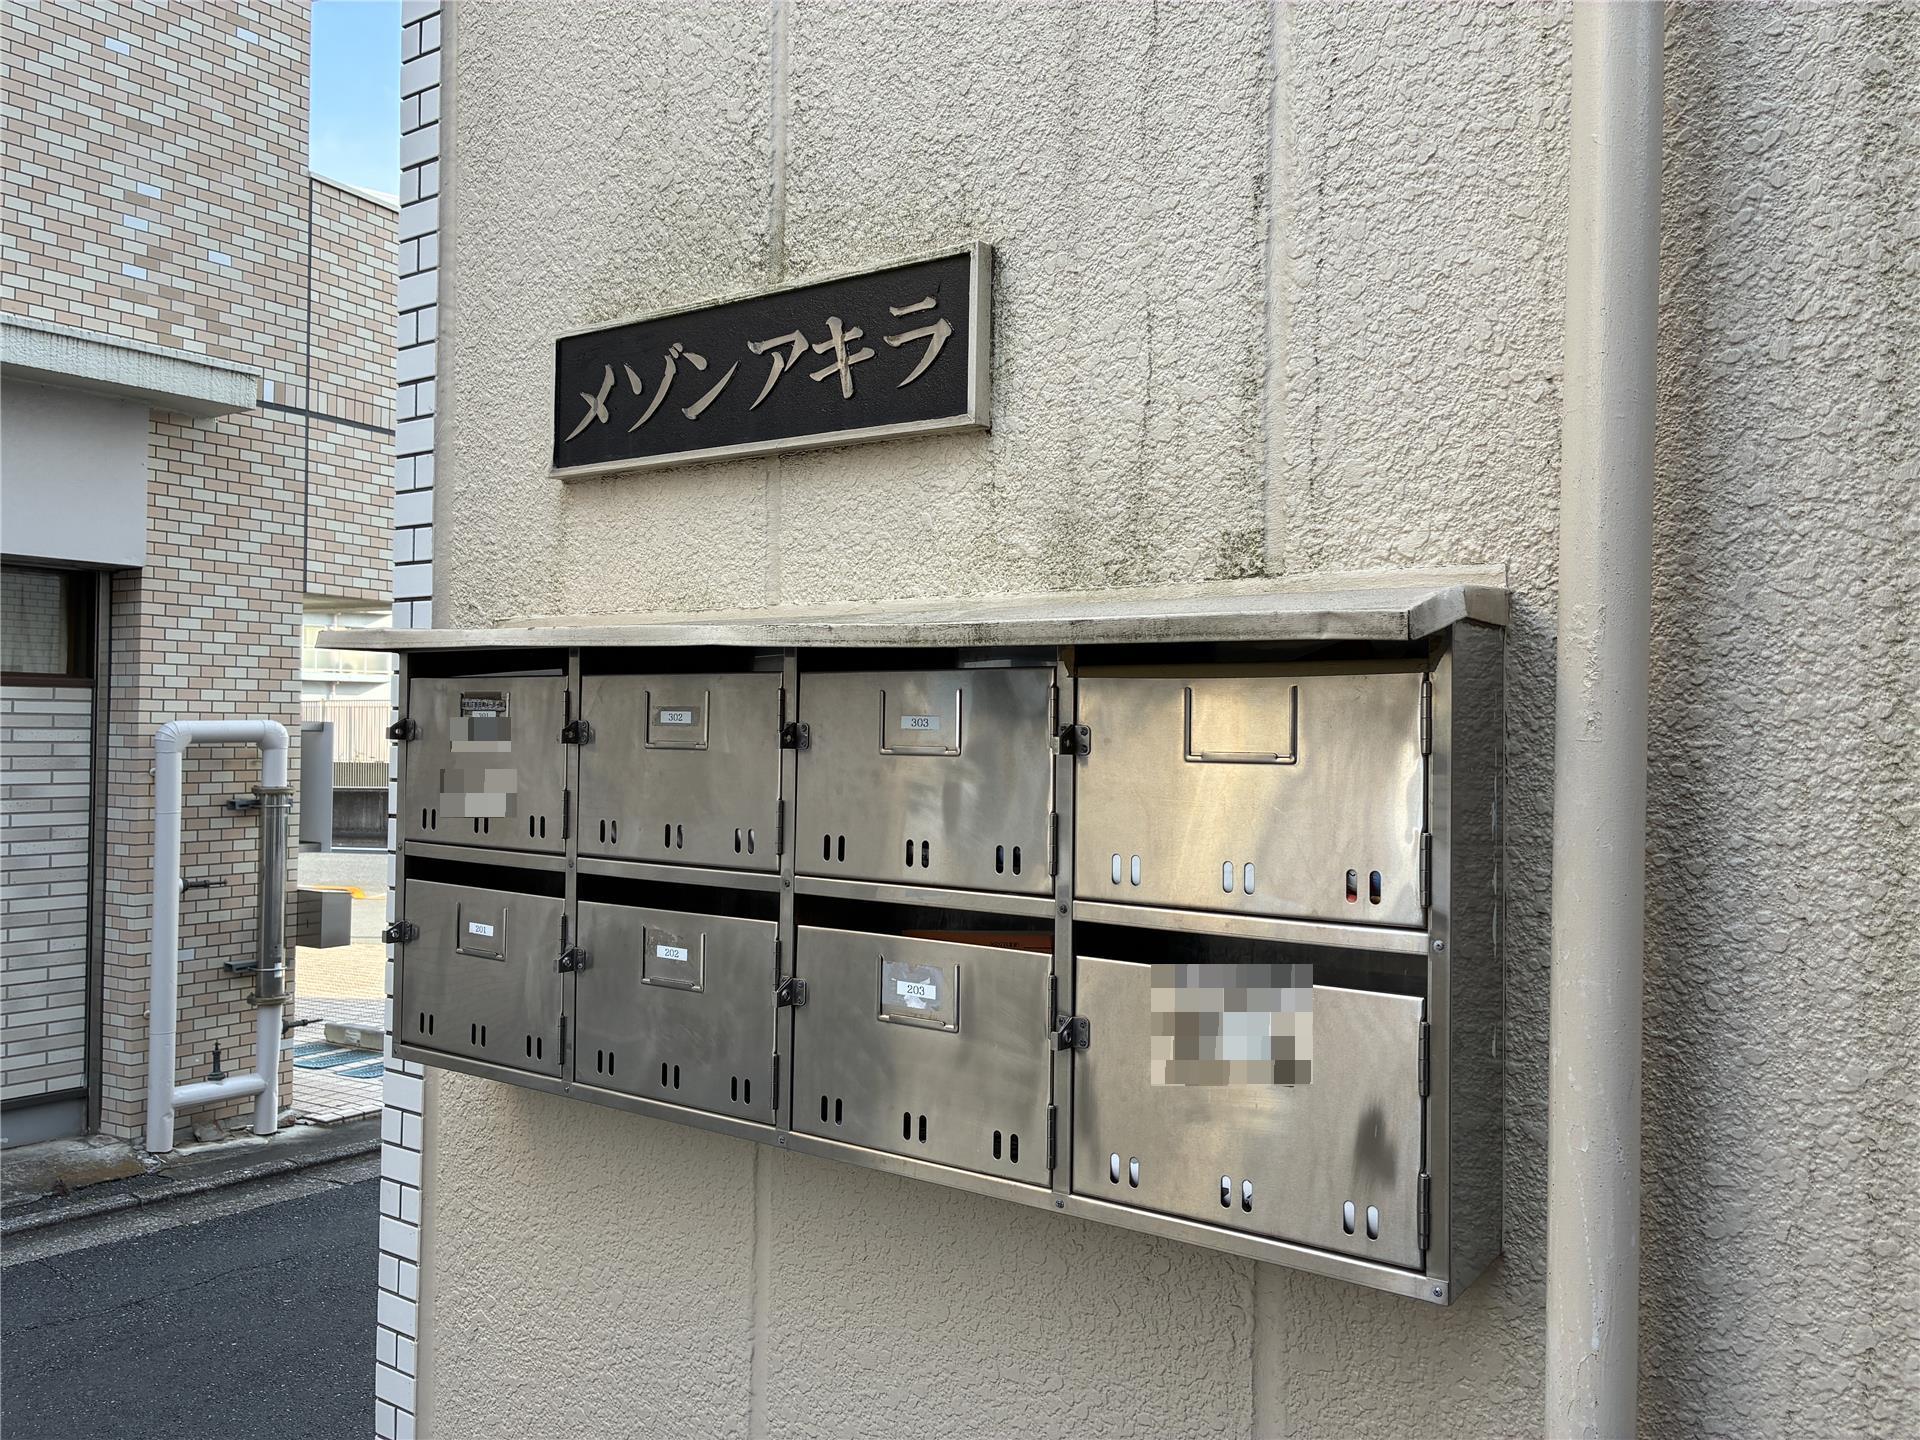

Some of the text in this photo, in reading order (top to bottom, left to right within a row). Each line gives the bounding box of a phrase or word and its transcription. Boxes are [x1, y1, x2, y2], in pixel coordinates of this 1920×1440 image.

[564, 296, 953, 442] メゾンアキラ
[668, 713, 683, 721] 302
[911, 717, 929, 728] 303
[475, 925, 487, 934] 201
[664, 948, 680, 958] 202
[907, 984, 925, 996] 203
